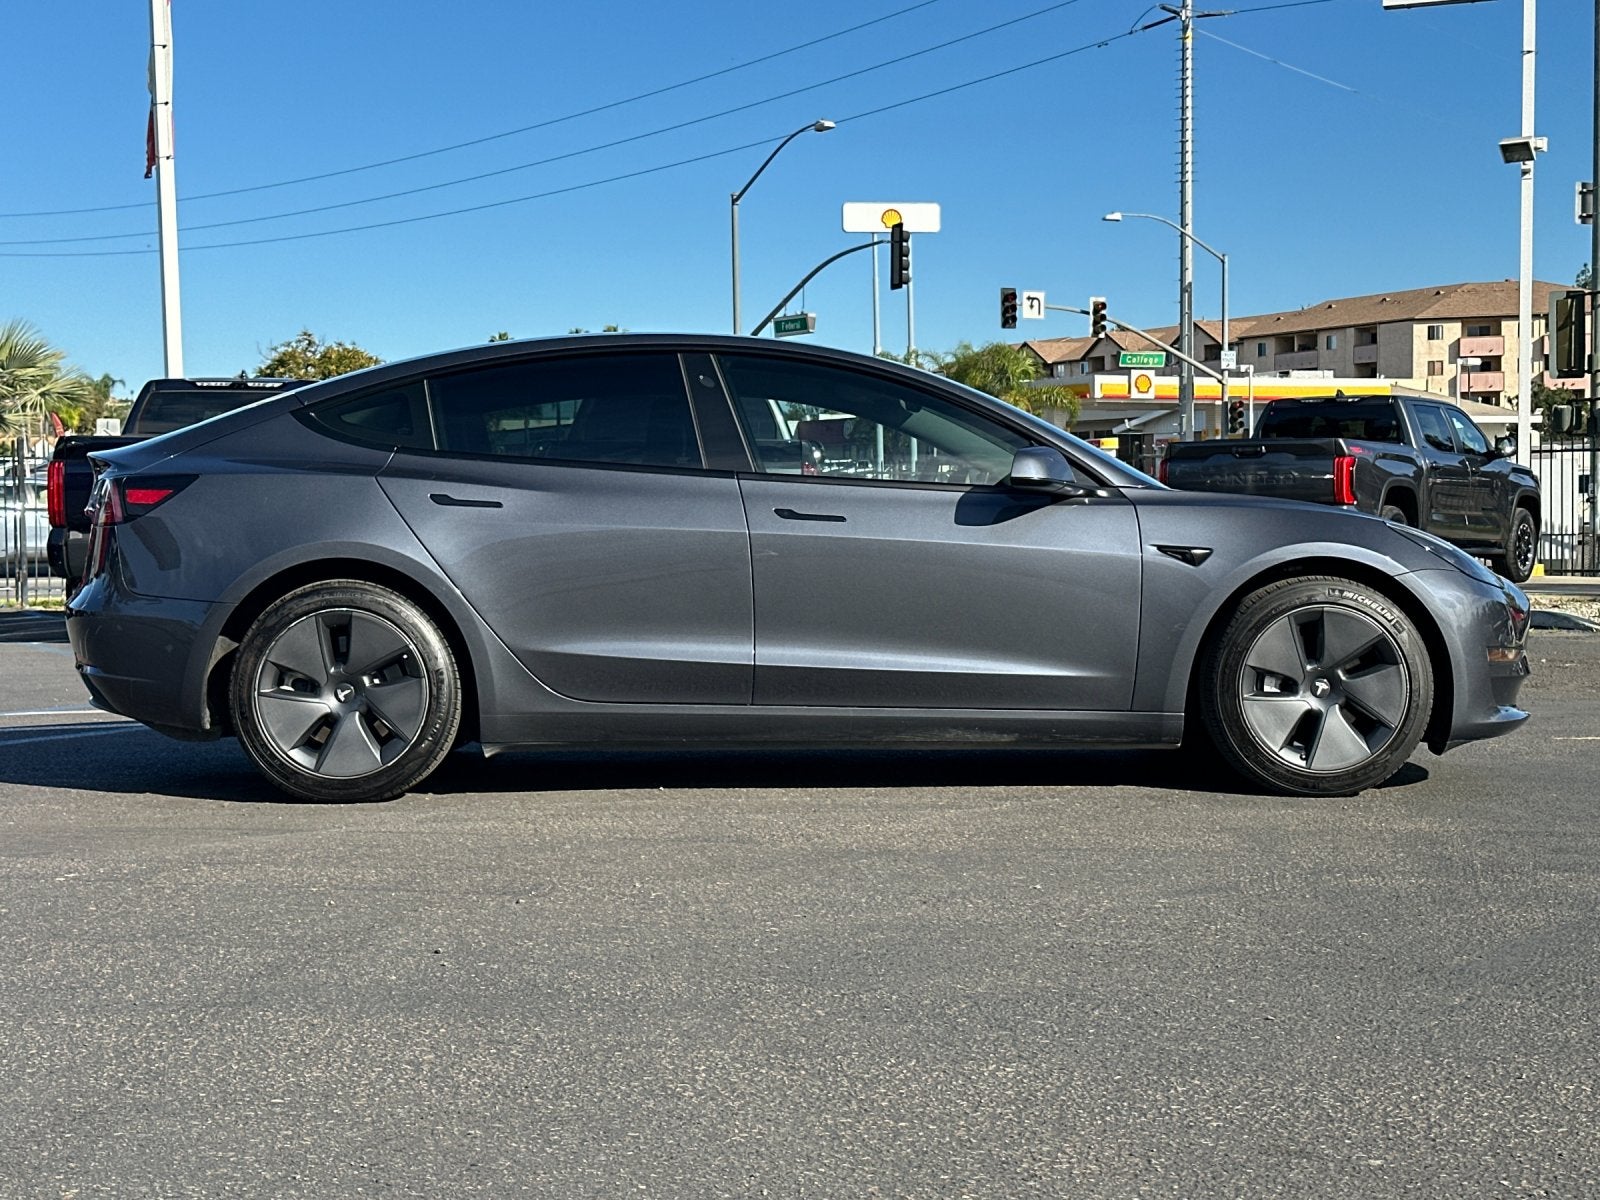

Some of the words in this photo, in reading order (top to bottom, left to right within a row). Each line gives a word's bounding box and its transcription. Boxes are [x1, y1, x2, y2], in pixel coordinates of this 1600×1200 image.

[781, 321, 801, 331] Federal
[1126, 355, 1159, 366] College
[1341, 590, 1395, 622] MICHELIN
